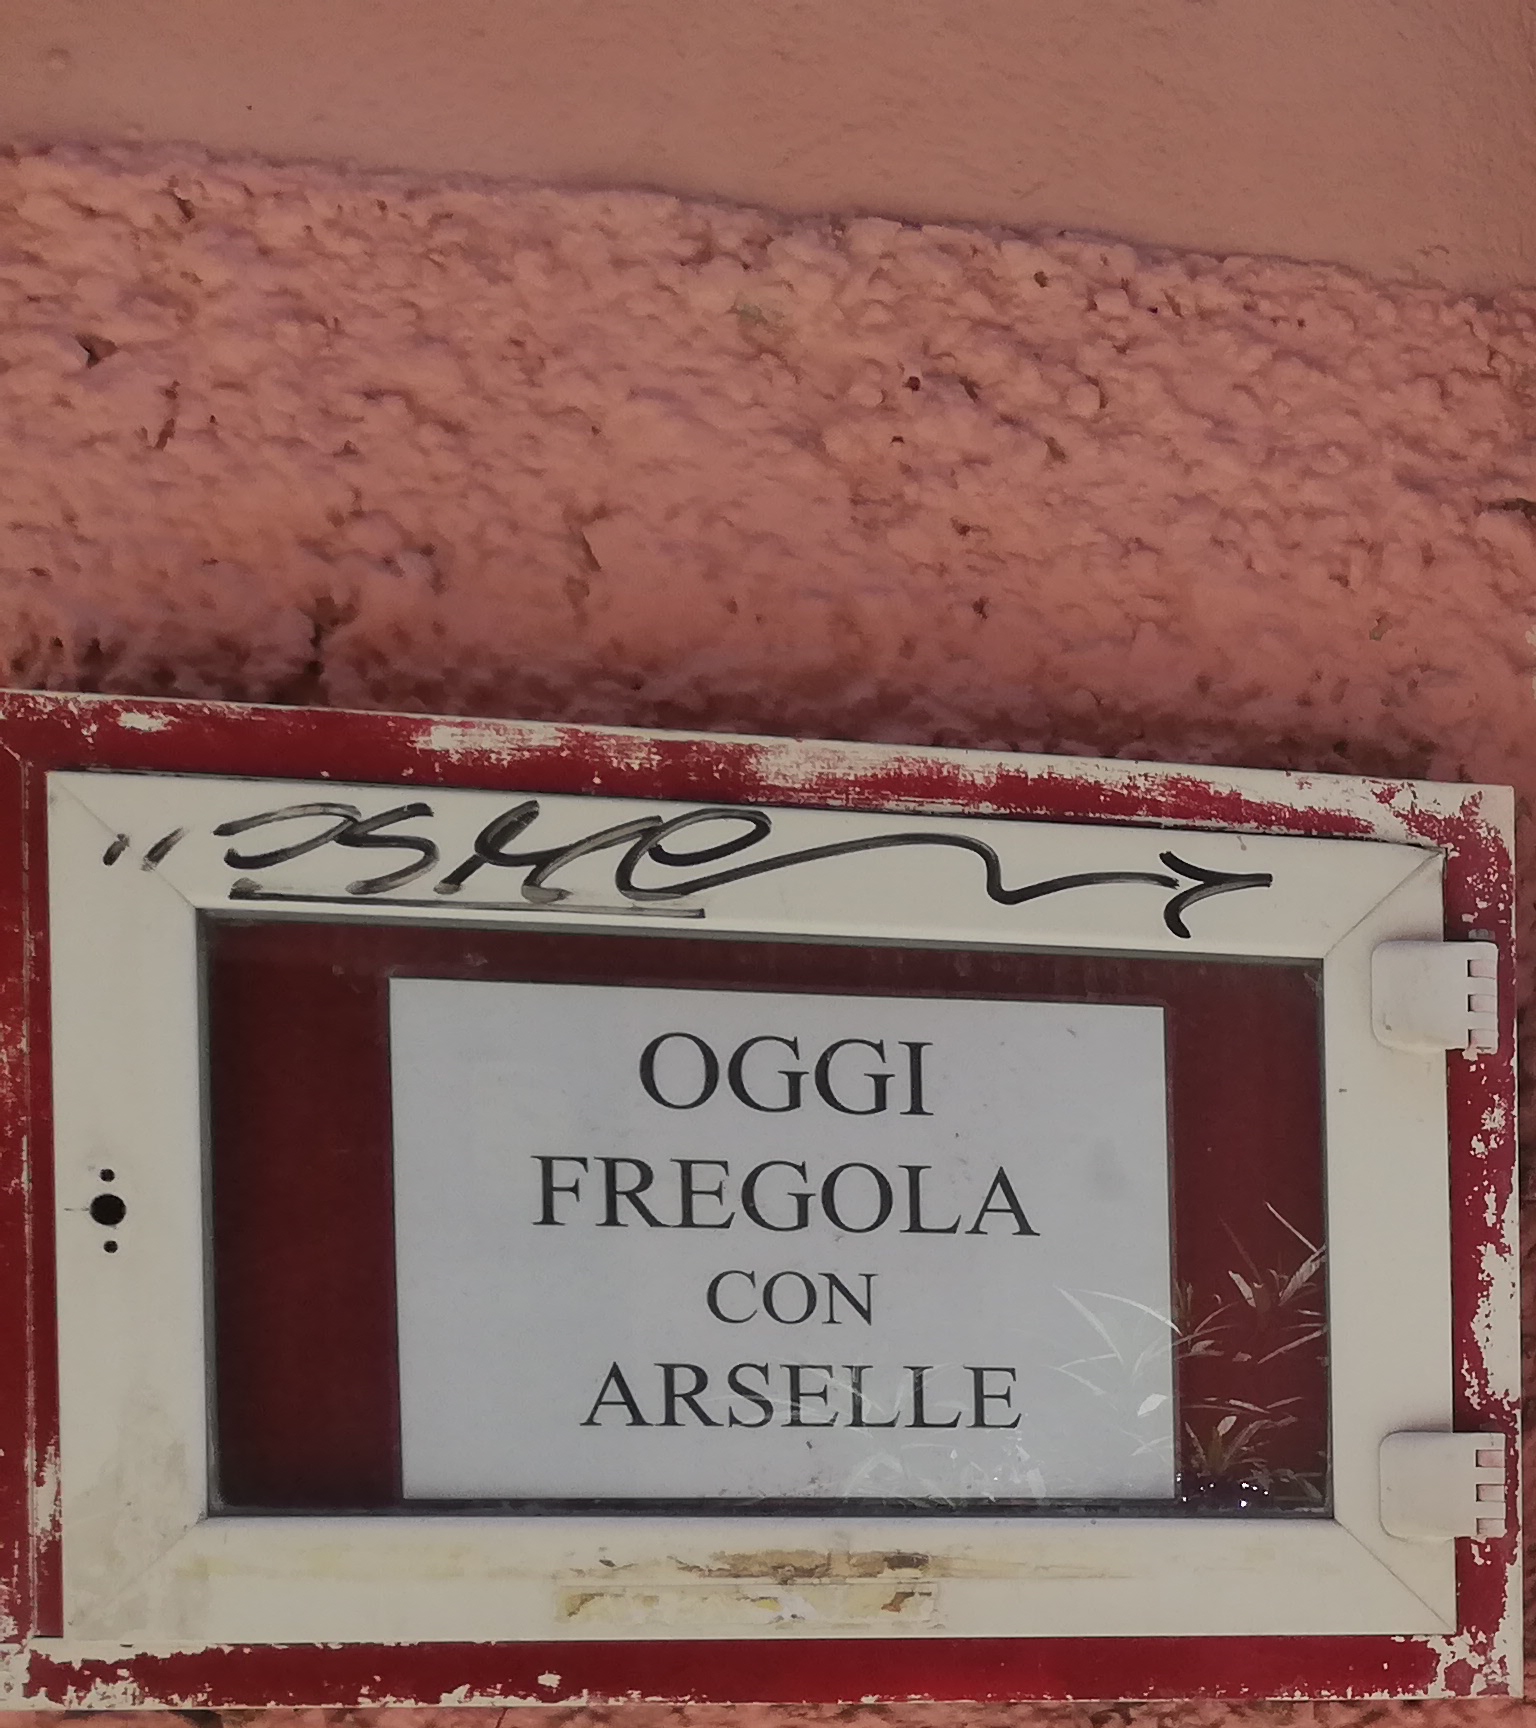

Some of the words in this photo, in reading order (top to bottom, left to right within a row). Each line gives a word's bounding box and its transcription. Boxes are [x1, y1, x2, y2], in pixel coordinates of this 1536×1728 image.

[639, 1031, 933, 1116] OGGI
[531, 1155, 1040, 1237] FREGOLA
[706, 1270, 878, 1326] CON
[579, 1361, 1022, 1429] ARSELLE
